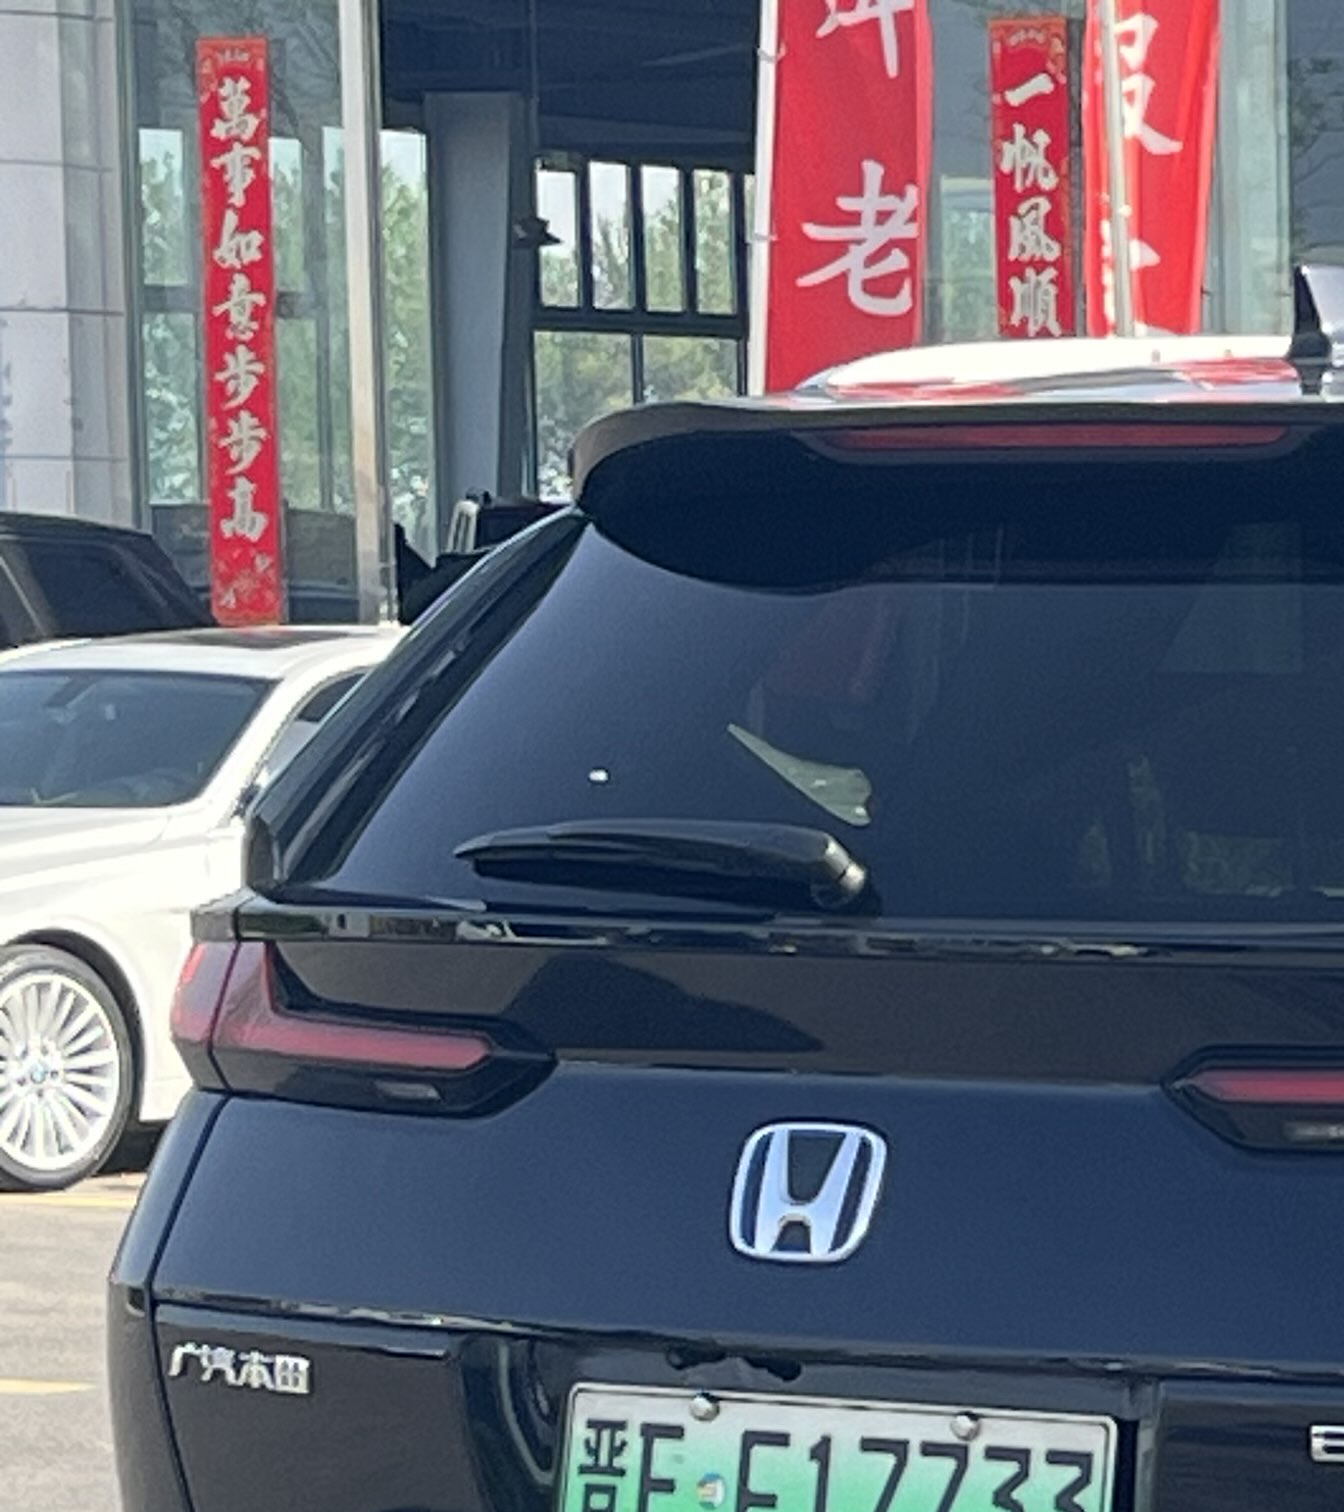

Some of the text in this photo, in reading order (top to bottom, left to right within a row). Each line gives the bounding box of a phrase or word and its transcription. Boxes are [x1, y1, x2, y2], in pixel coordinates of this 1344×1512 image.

[209, 75, 270, 542] 萬事如意步步高
[168, 1342, 310, 1395] 广汽本田
